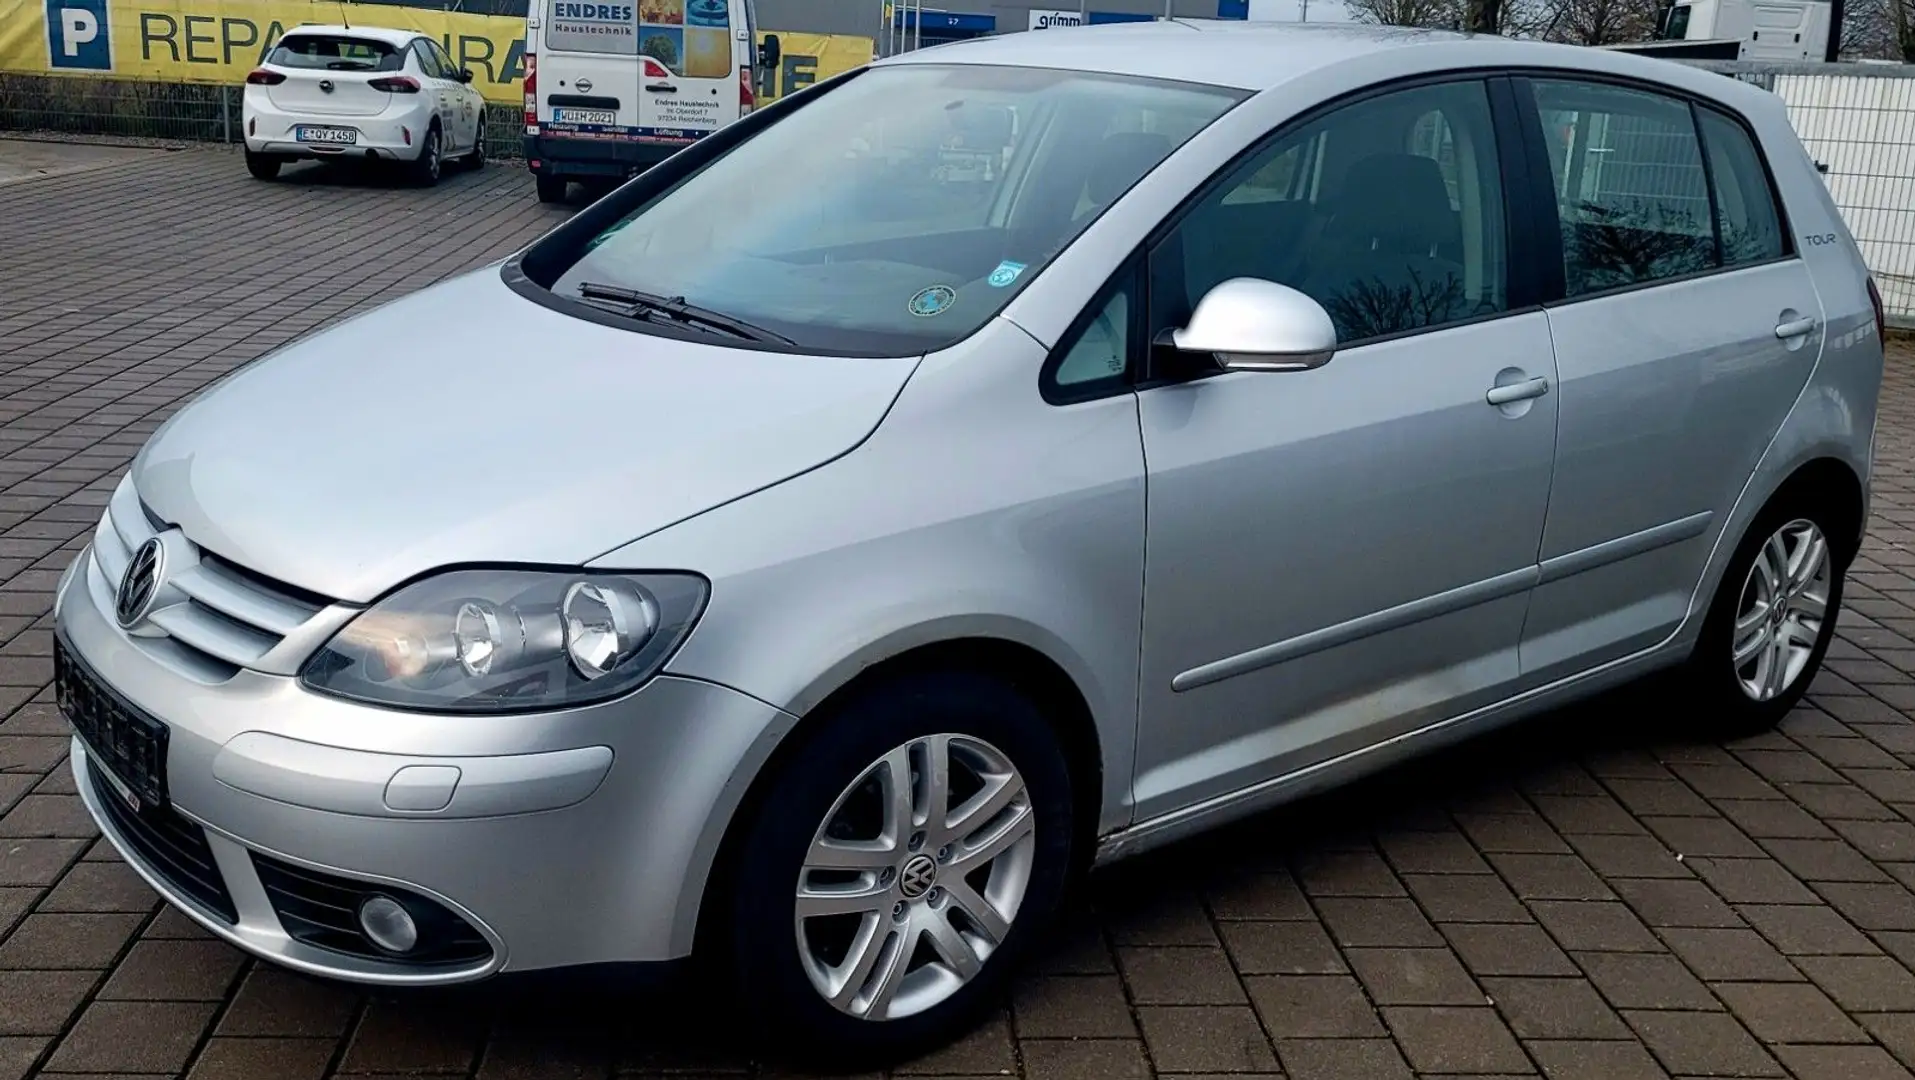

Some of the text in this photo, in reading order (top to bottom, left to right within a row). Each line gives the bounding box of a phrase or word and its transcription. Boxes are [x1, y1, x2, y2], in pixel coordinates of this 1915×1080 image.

[555, 2, 632, 20] ENDRES
[61, 8, 98, 57] P
[555, 23, 632, 36] Haustechnik
[655, 99, 720, 109] Endres Haustechnik
[588, 112, 613, 124] 2021
[1804, 233, 1837, 246] TOUR
